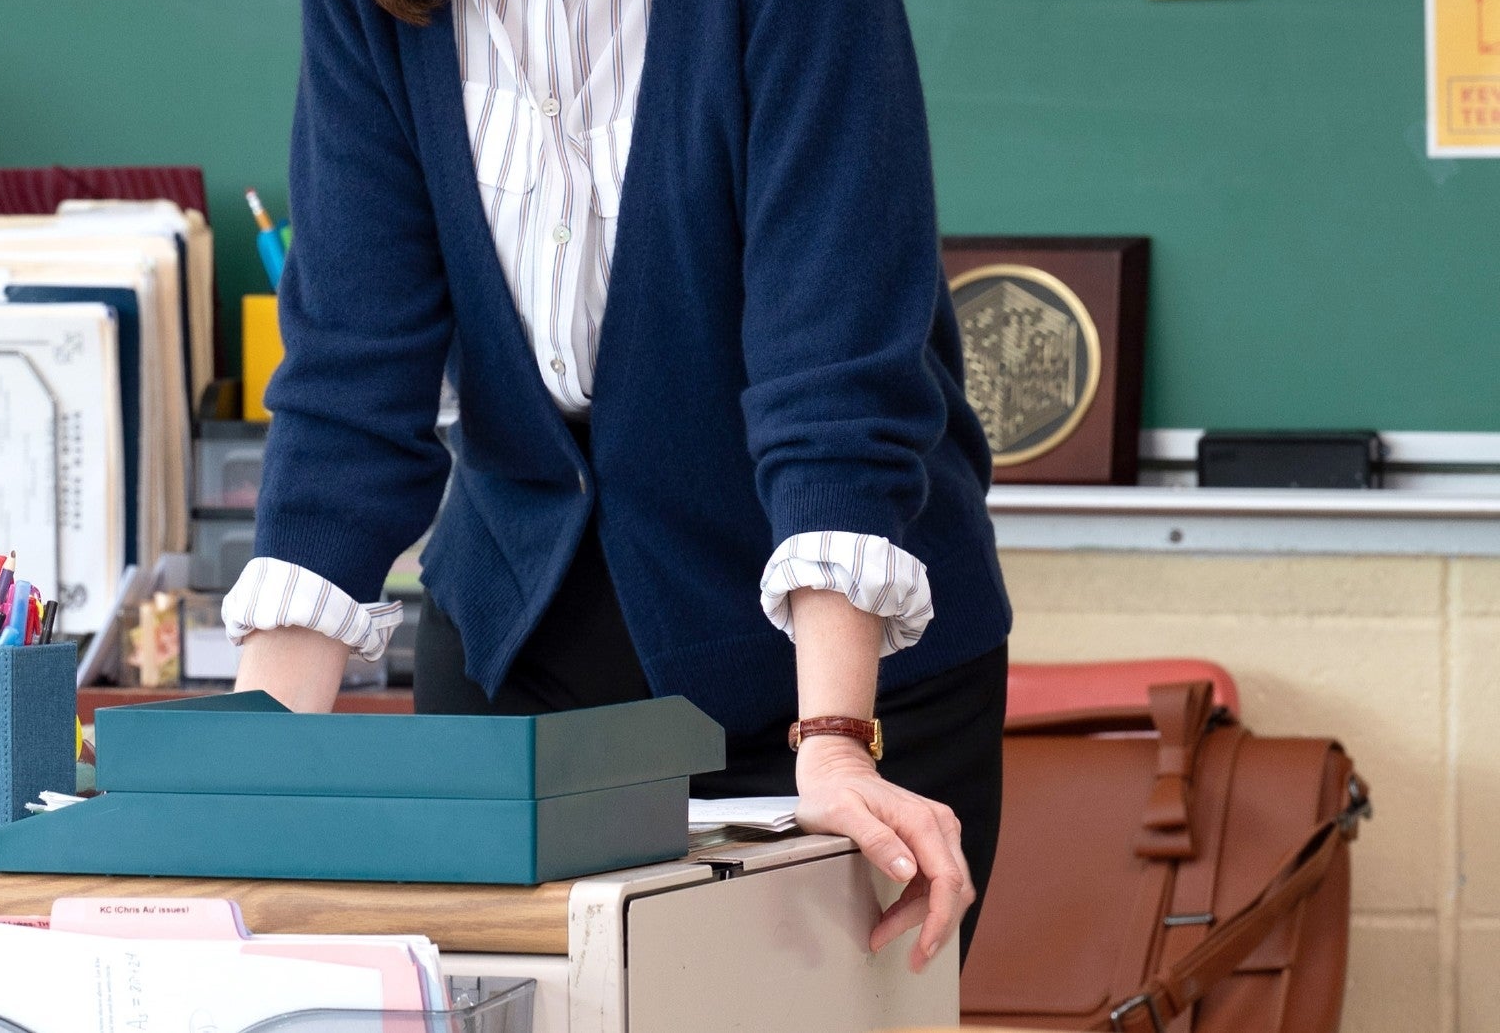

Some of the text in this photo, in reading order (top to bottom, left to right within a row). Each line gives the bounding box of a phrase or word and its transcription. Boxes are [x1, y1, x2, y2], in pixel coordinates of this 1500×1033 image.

[100, 906, 112, 914] KC
[114, 906, 140, 914] (Chris
[159, 905, 190, 914] issues)
